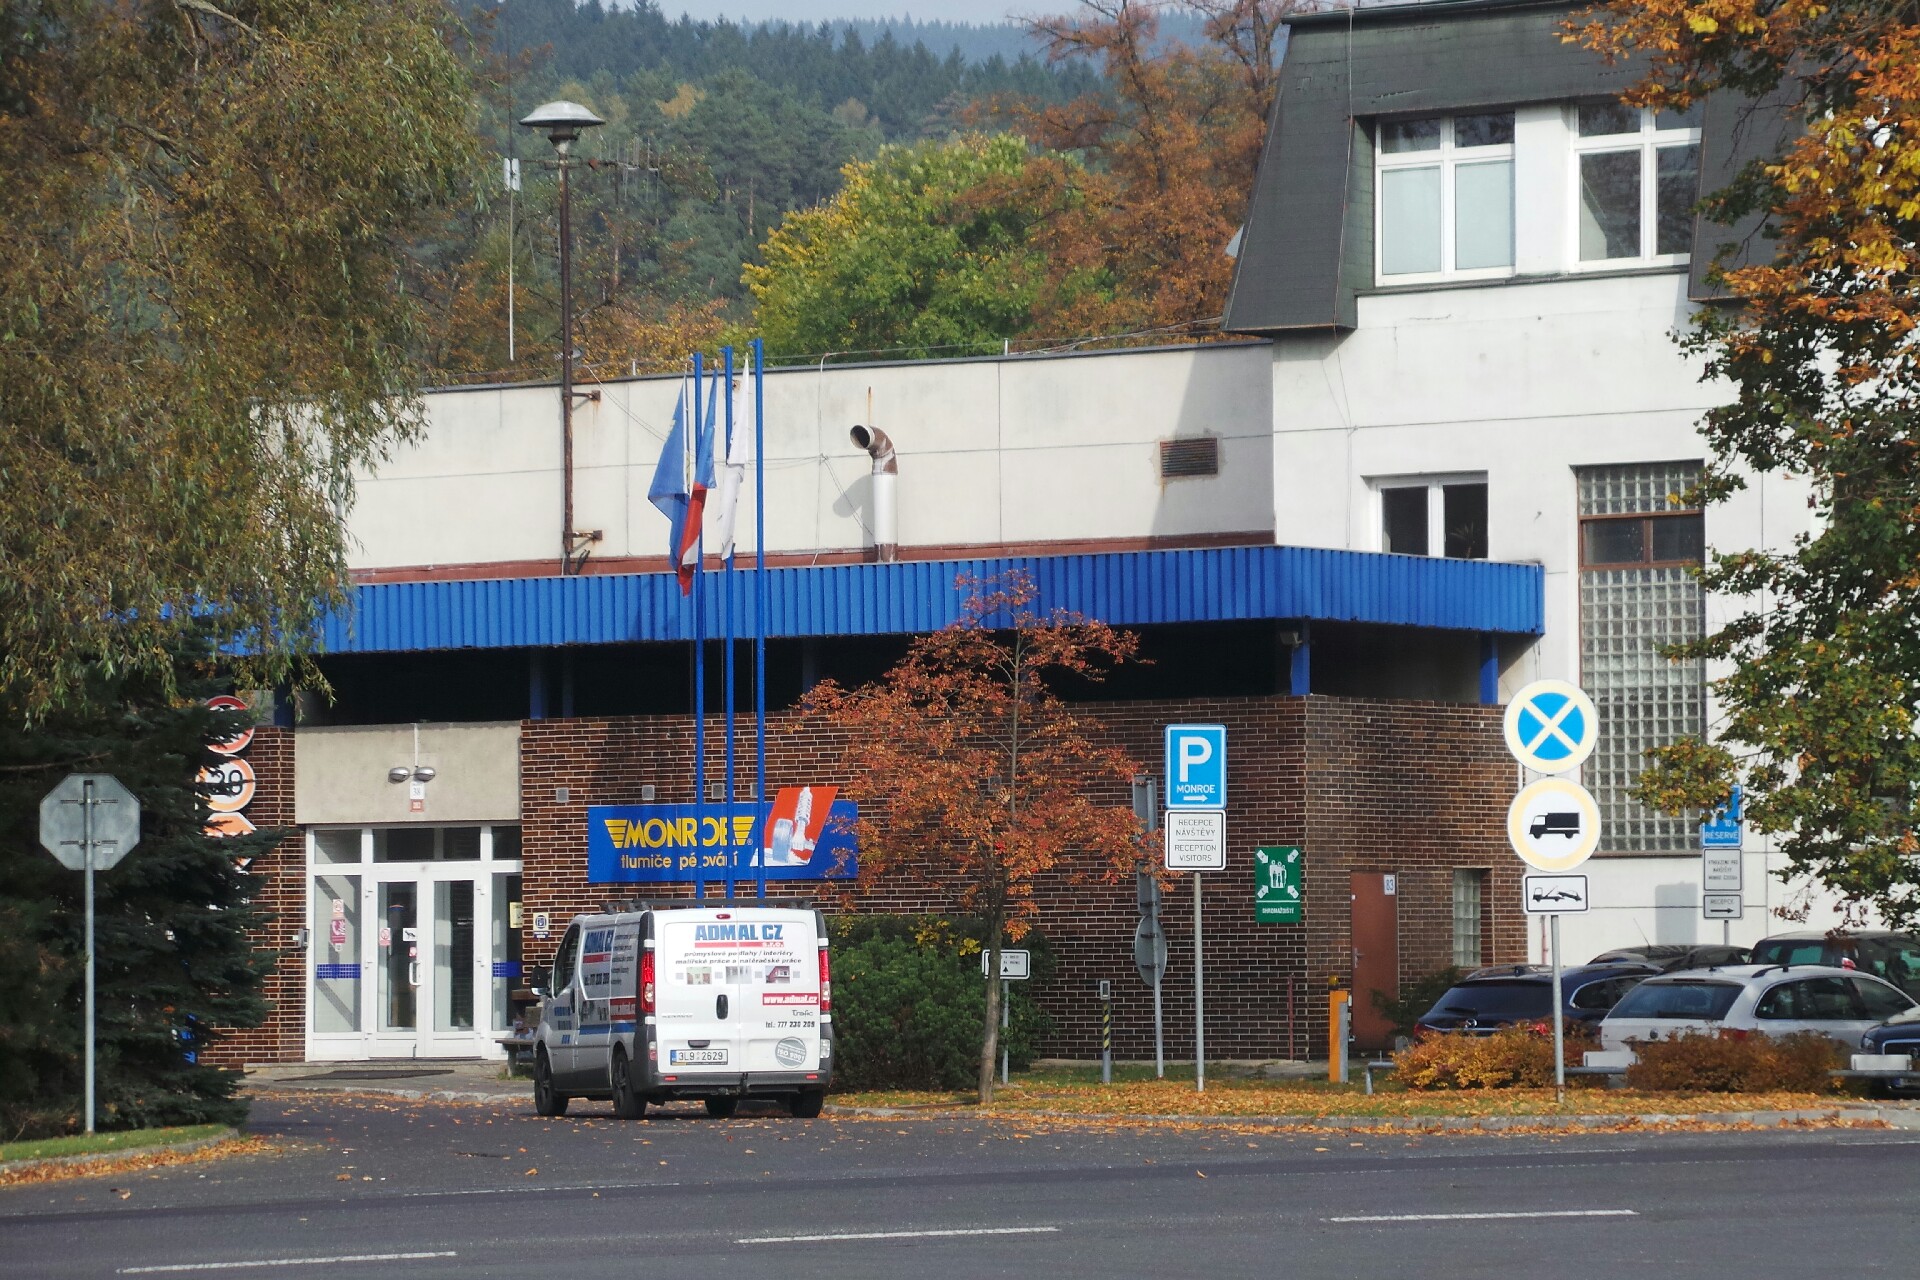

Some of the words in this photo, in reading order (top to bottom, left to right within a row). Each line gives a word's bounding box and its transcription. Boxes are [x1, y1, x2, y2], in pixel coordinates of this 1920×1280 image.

[1179, 736, 1213, 783] P
[1176, 784, 1216, 794] MONROE
[1178, 819, 1214, 827] RECEPCE
[1175, 827, 1216, 836] NÁVŠTĚVY
[1174, 844, 1217, 852] RECEPTION
[620, 853, 672, 869] tlumiče
[680, 850, 739, 871] péováí
[1179, 854, 1213, 862] VISITORS
[695, 924, 759, 941] ADMAL
[761, 924, 784, 940] CZ
[764, 995, 817, 1004] www.admal.cz
[679, 1051, 695, 1061] 3L9
[702, 1051, 723, 1061] 2629
